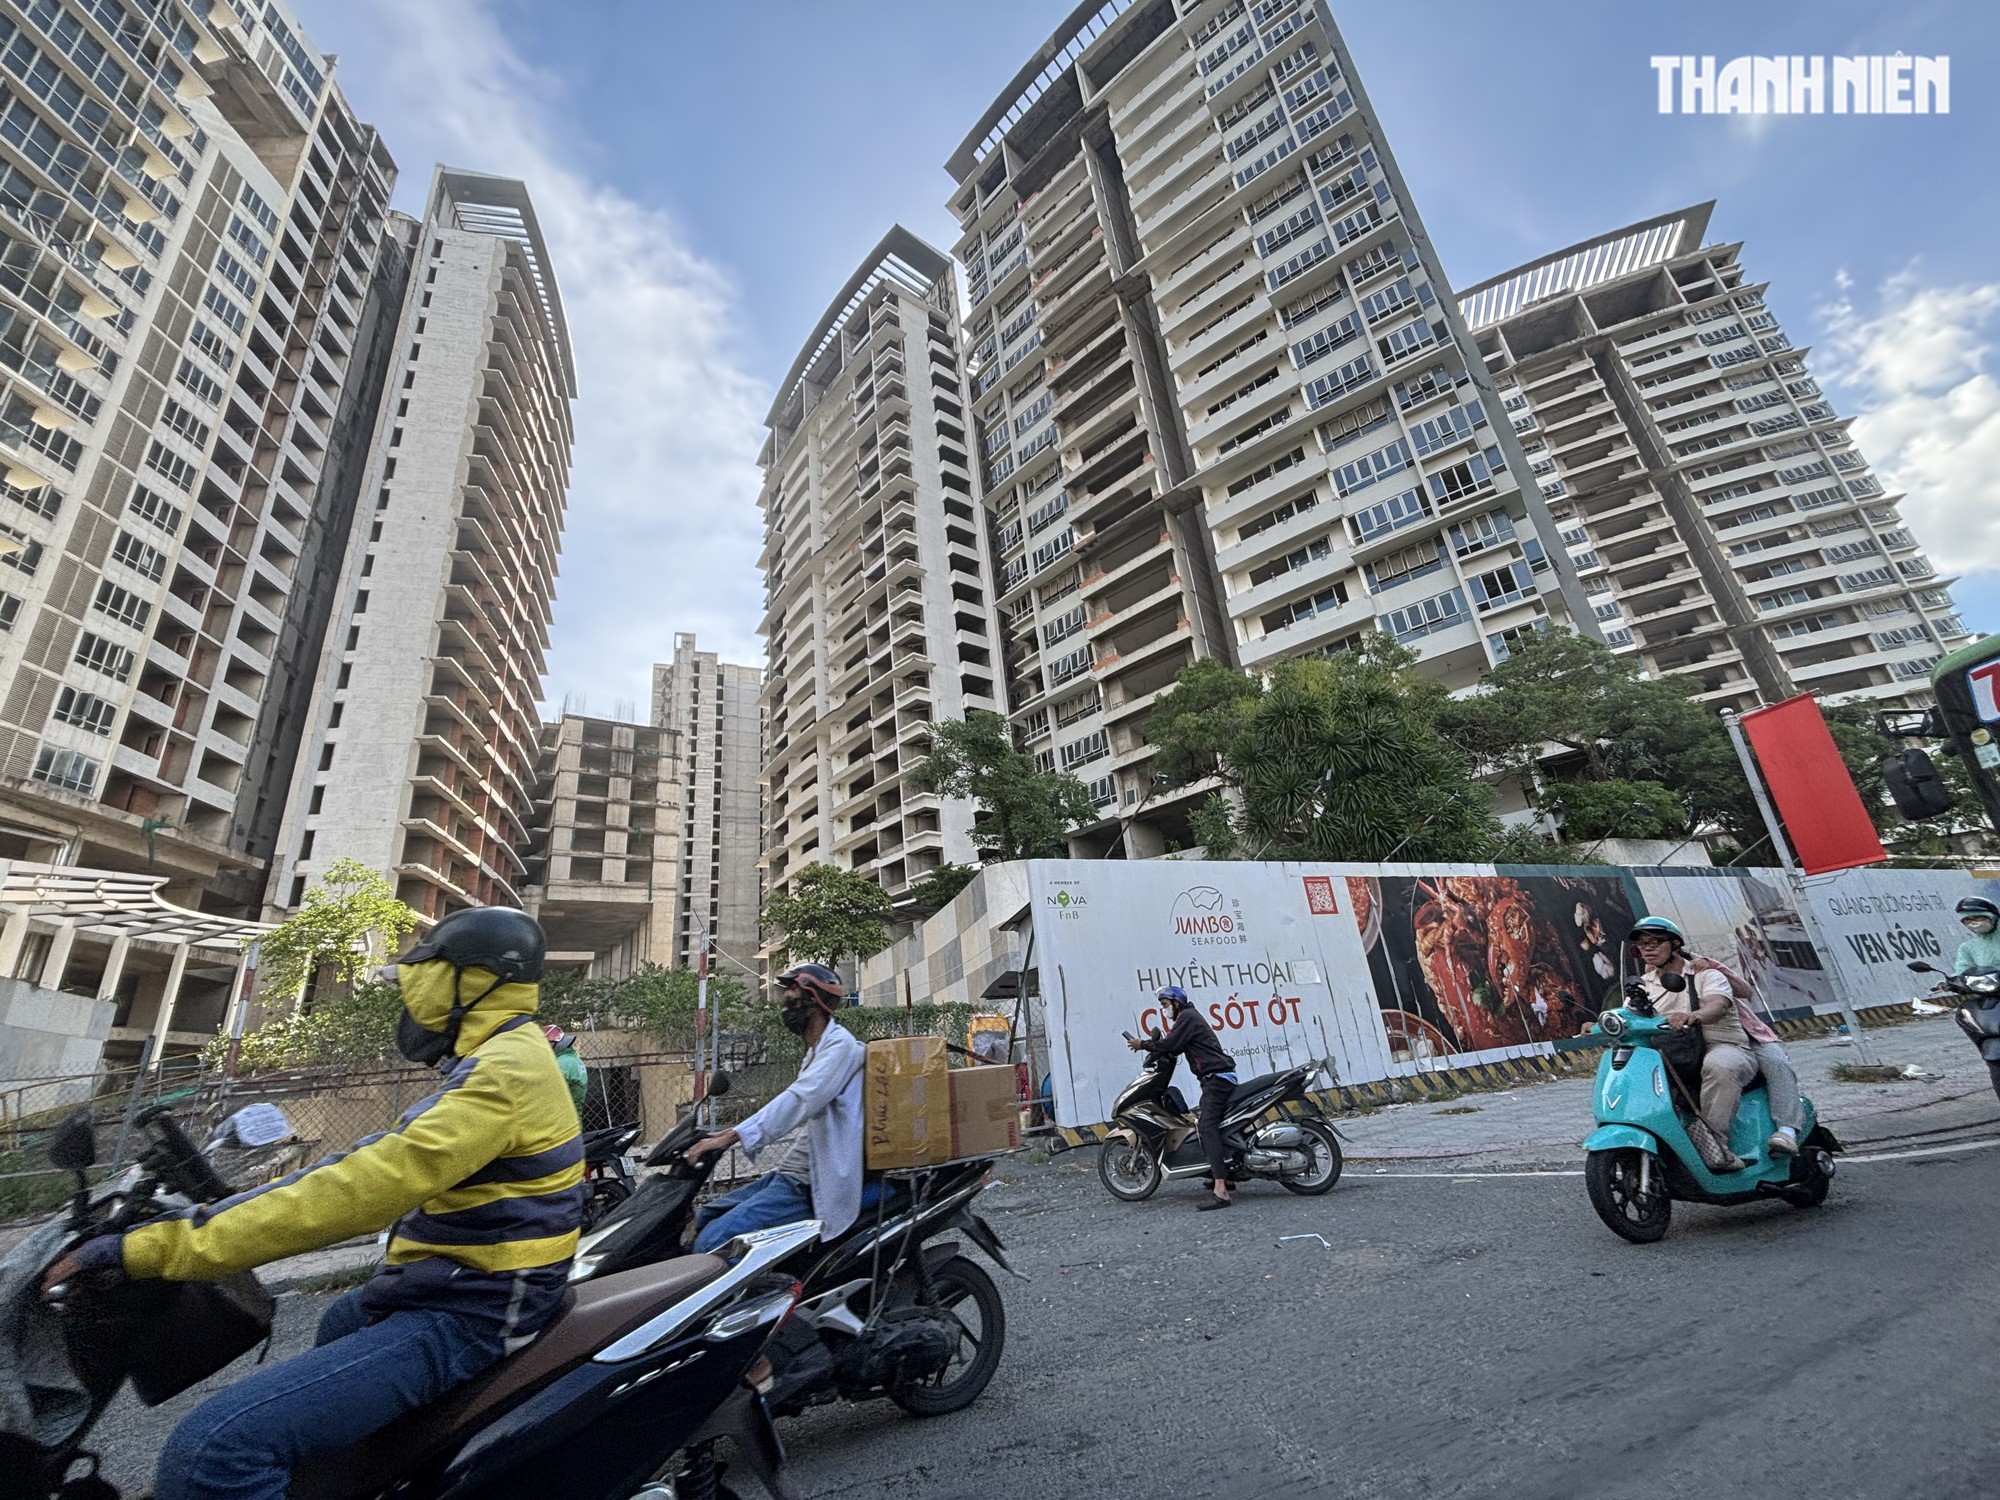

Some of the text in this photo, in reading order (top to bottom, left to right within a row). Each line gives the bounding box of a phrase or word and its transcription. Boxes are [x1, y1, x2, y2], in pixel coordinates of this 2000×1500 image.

[1059, 910, 1079, 920] FnB
[1174, 915, 1234, 935] JUMBO
[1191, 936, 1237, 946] SEAFOOD
[1844, 922, 1941, 965] VEN SÔNG
[1222, 961, 1292, 988] THOẠI
[1230, 1045, 1260, 1057] Seafood
